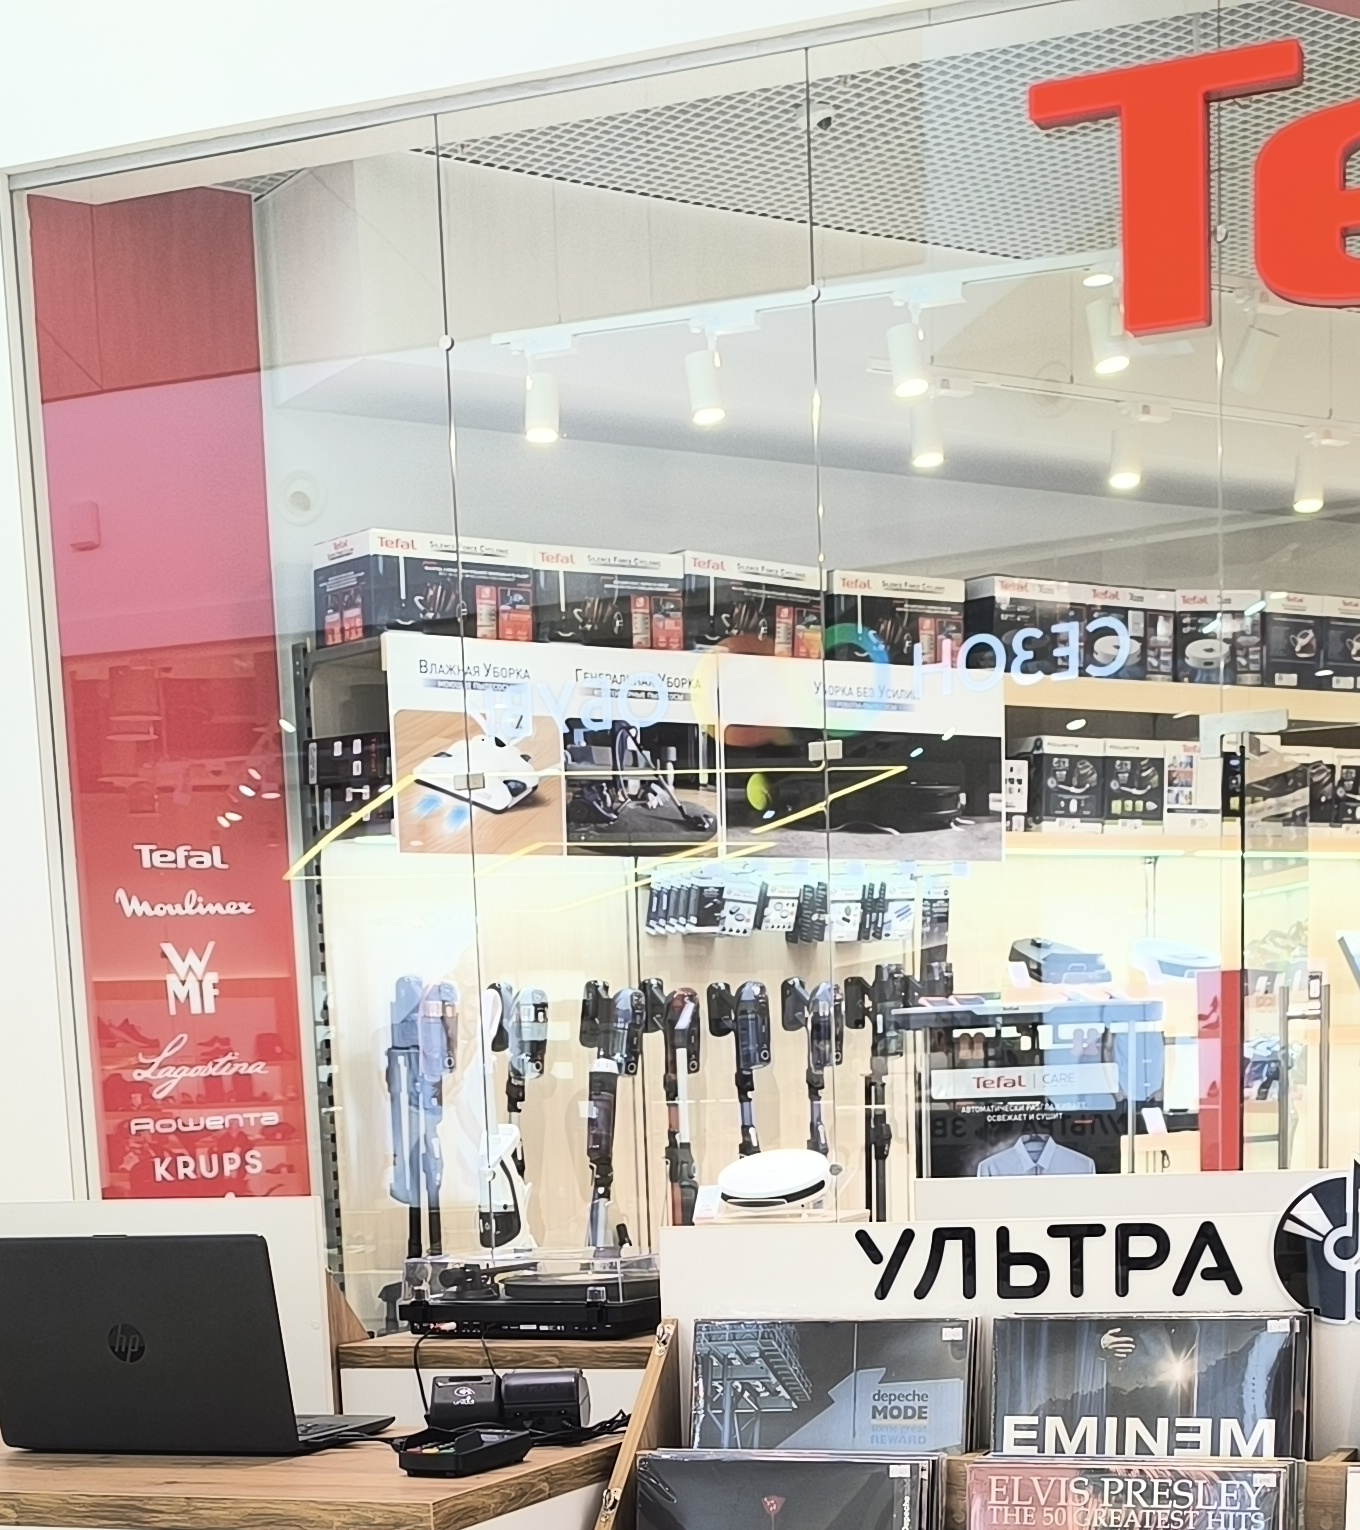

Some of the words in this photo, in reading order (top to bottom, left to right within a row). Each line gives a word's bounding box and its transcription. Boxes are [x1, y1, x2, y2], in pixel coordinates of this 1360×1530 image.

[378, 536, 418, 550] Tefal
[540, 552, 576, 565] Tefal
[692, 557, 726, 571] Tefal
[840, 578, 872, 589] Tefal
[1180, 594, 1208, 606] Tefal
[133, 844, 229, 869] Tefal
[115, 887, 256, 918] Moulinex
[132, 1033, 269, 1100] Lagostina
[973, 1075, 1026, 1089] Tefal
[1042, 1073, 1076, 1084] CARE
[154, 1149, 263, 1182] KRUPS
[854, 1221, 1243, 1301] УЛЬТРА
[871, 1389, 929, 1412] depeche
[871, 1405, 929, 1421] MODE
[870, 1434, 928, 1446] REWARD
[987, 1474, 1091, 1508] ELVIS
[1099, 1477, 1267, 1511] PRESLEY
[987, 1506, 1036, 1526] THE
[1042, 1508, 1066, 1527] 50
[1072, 1508, 1200, 1530] GREATEST
